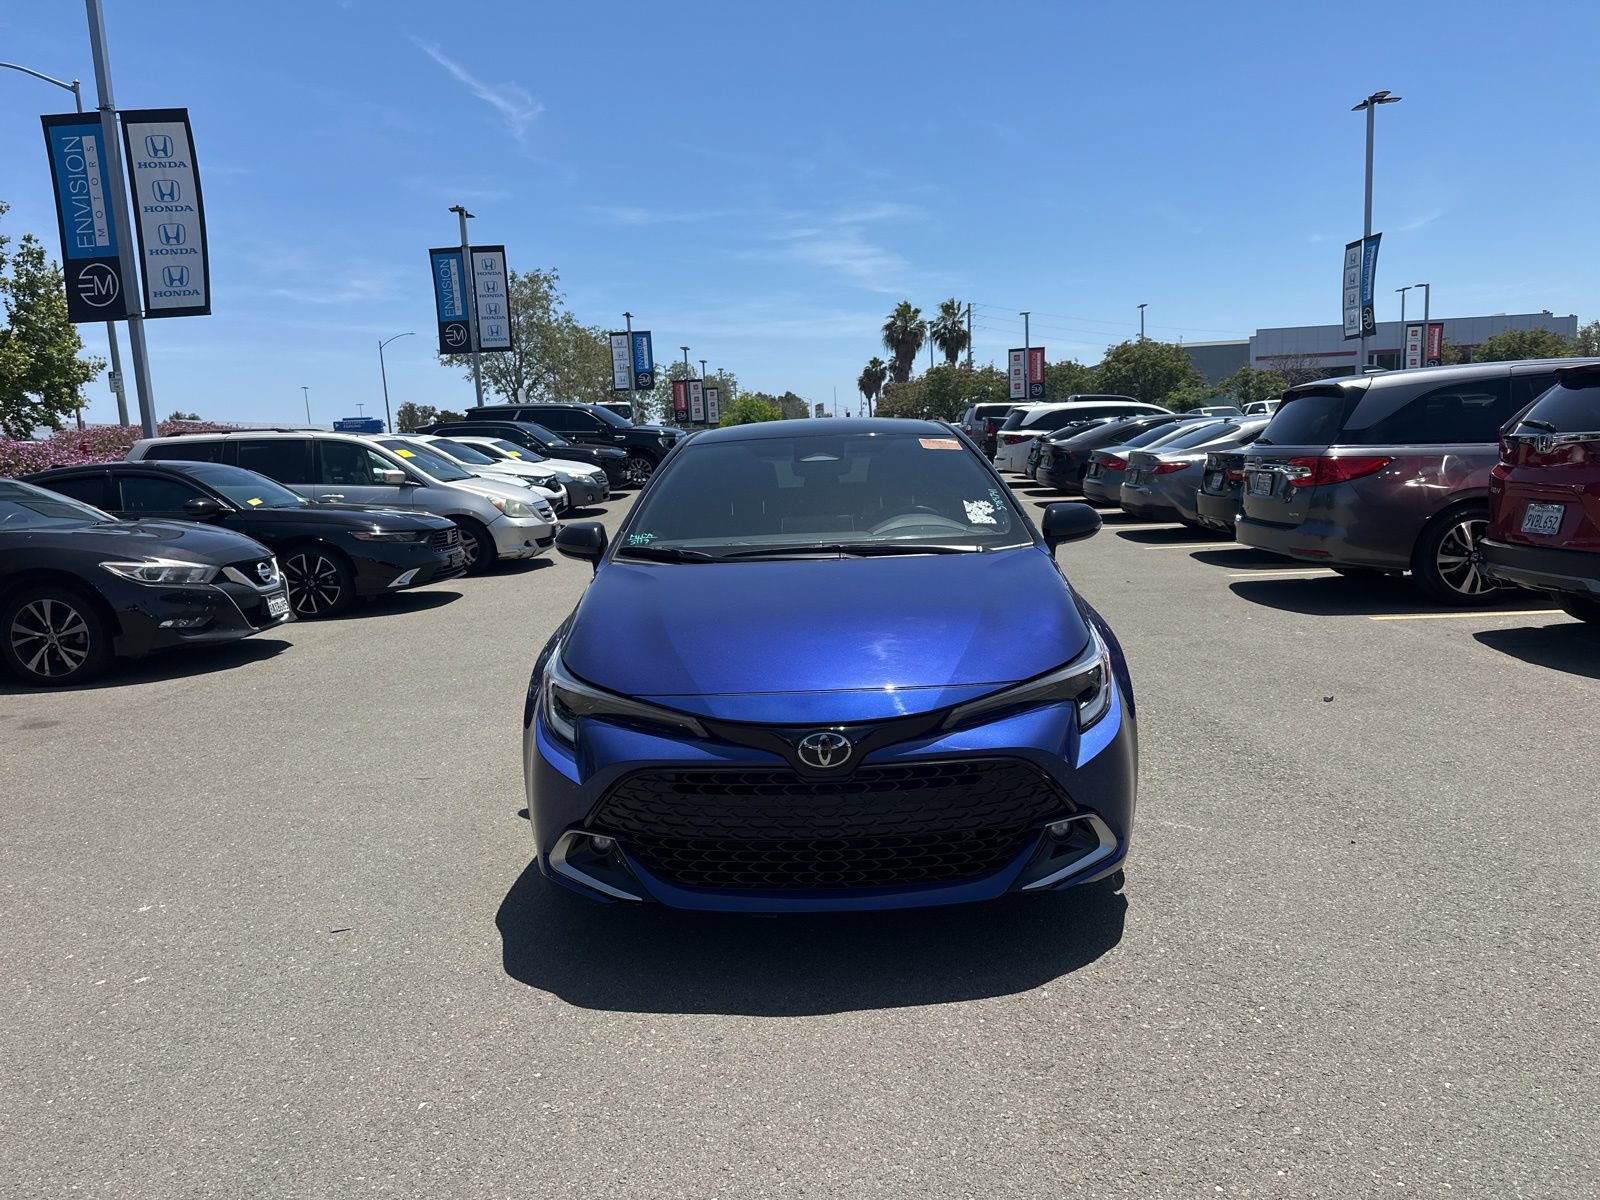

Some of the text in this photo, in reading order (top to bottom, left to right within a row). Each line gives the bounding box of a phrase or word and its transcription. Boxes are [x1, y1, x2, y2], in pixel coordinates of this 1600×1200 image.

[137, 161, 188, 169] HONDA
[62, 136, 96, 249] ENVISION
[86, 145, 106, 238] MOTORS
[144, 205, 194, 213] HONDA
[150, 247, 198, 256] HONDA
[153, 290, 201, 298] HONDA
[440, 259, 455, 317] ENVISION
[636, 336, 644, 369] ENVISION
[1525, 513, 1559, 529] 9VBL652
